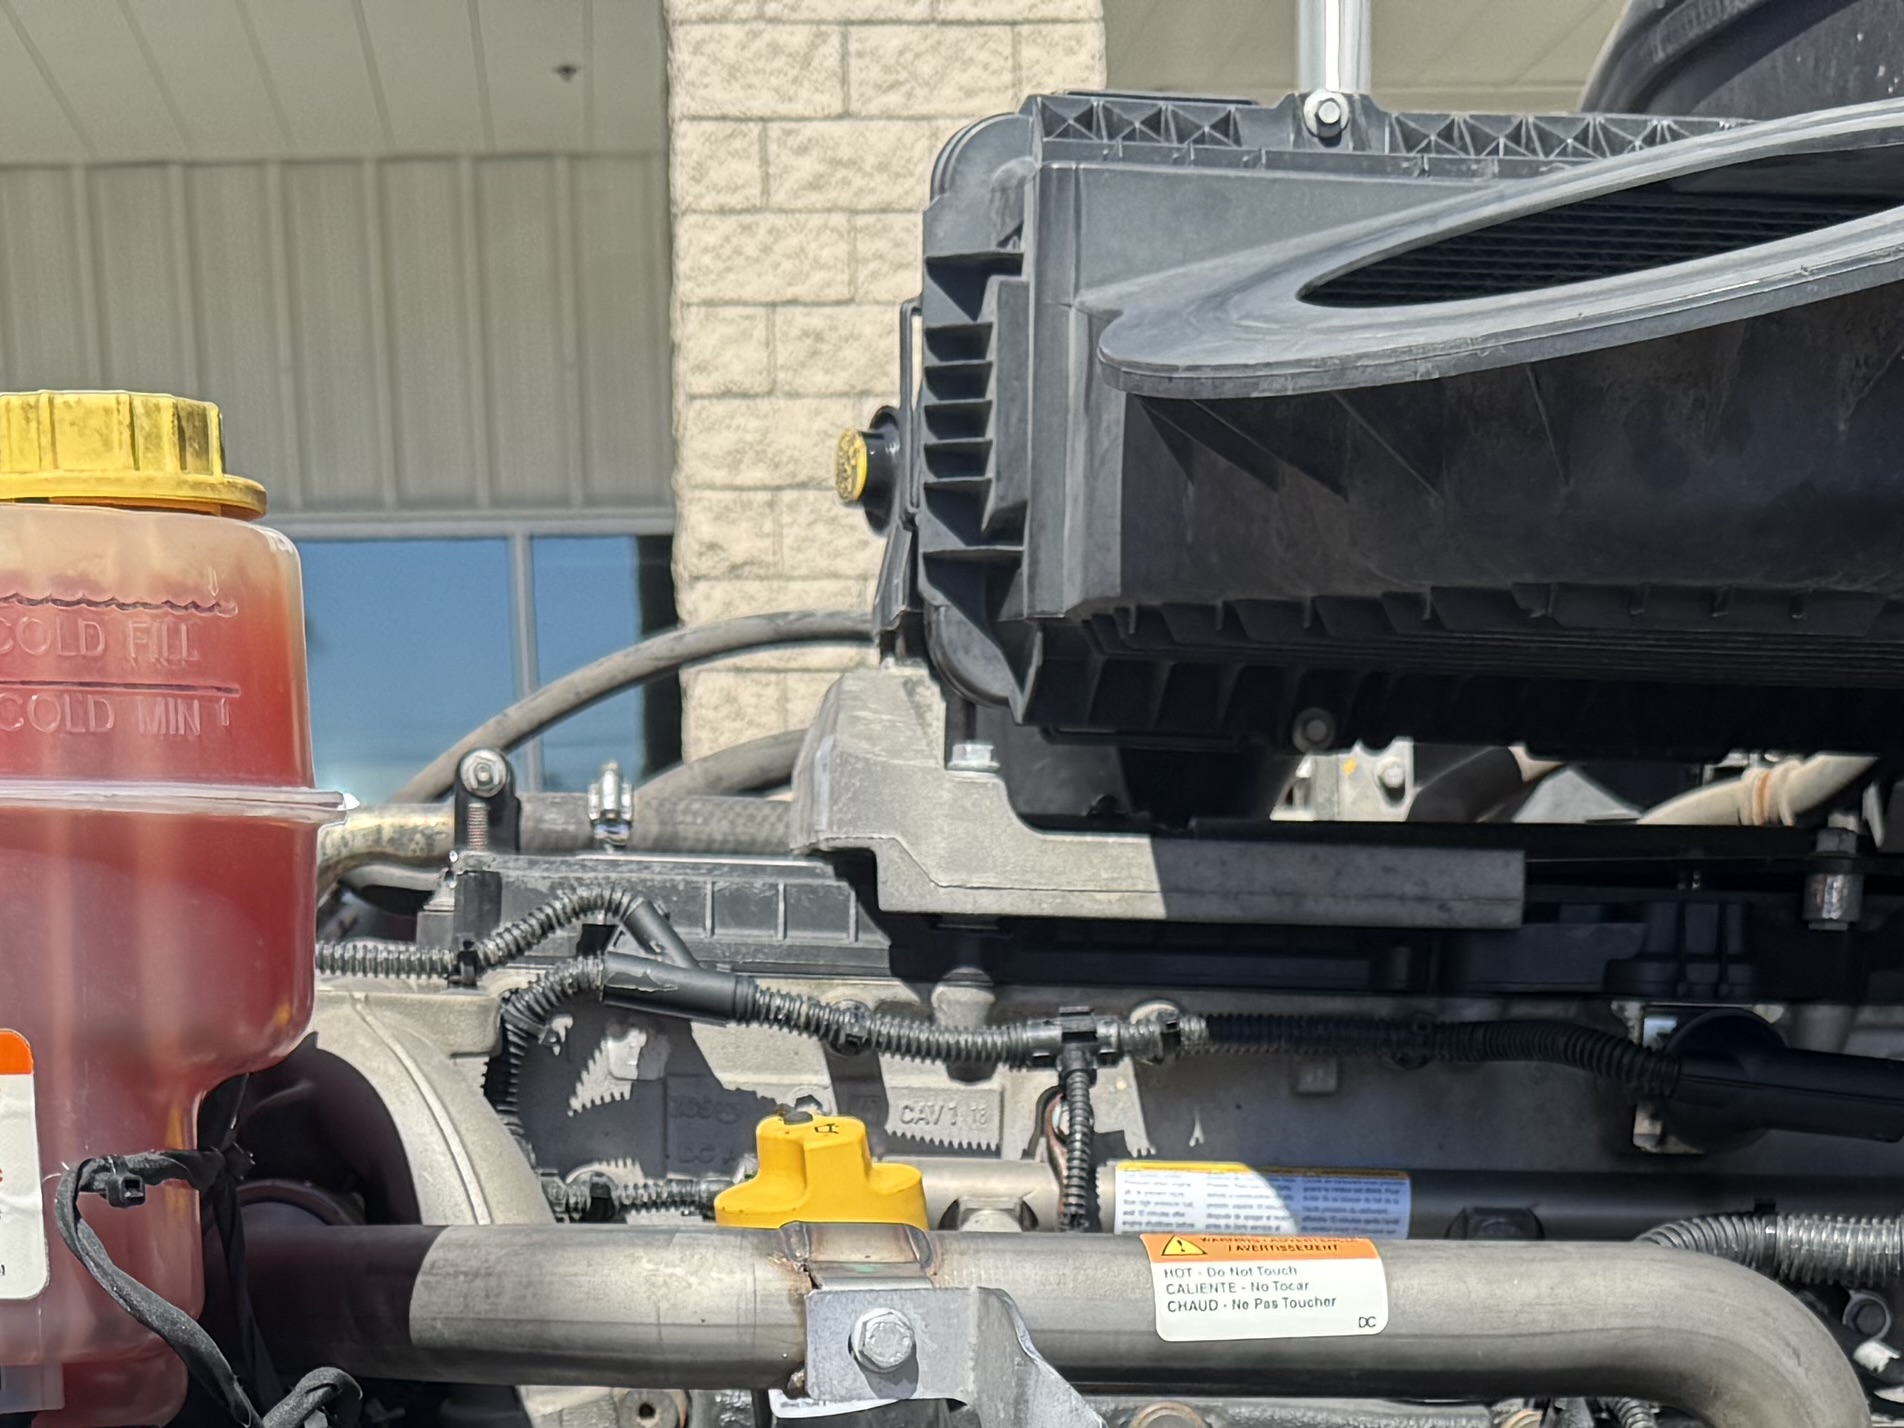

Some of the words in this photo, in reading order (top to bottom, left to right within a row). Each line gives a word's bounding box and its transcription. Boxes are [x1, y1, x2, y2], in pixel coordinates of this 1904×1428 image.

[126, 621, 200, 661] FILL
[139, 697, 200, 736] MIN
[1164, 1267, 1192, 1279] HOT
[1207, 1266, 1224, 1277] Do
[1230, 1266, 1253, 1277] Not
[1256, 1265, 1297, 1276] Touch
[1166, 1282, 1237, 1295] CALIENTE
[1251, 1281, 1269, 1293] No
[1272, 1280, 1309, 1292] Tocar
[1168, 1300, 1218, 1312] CHAUD
[1255, 1298, 1278, 1310] Pas
[1282, 1297, 1336, 1309] Toucher
[1358, 1316, 1376, 1328] DC
